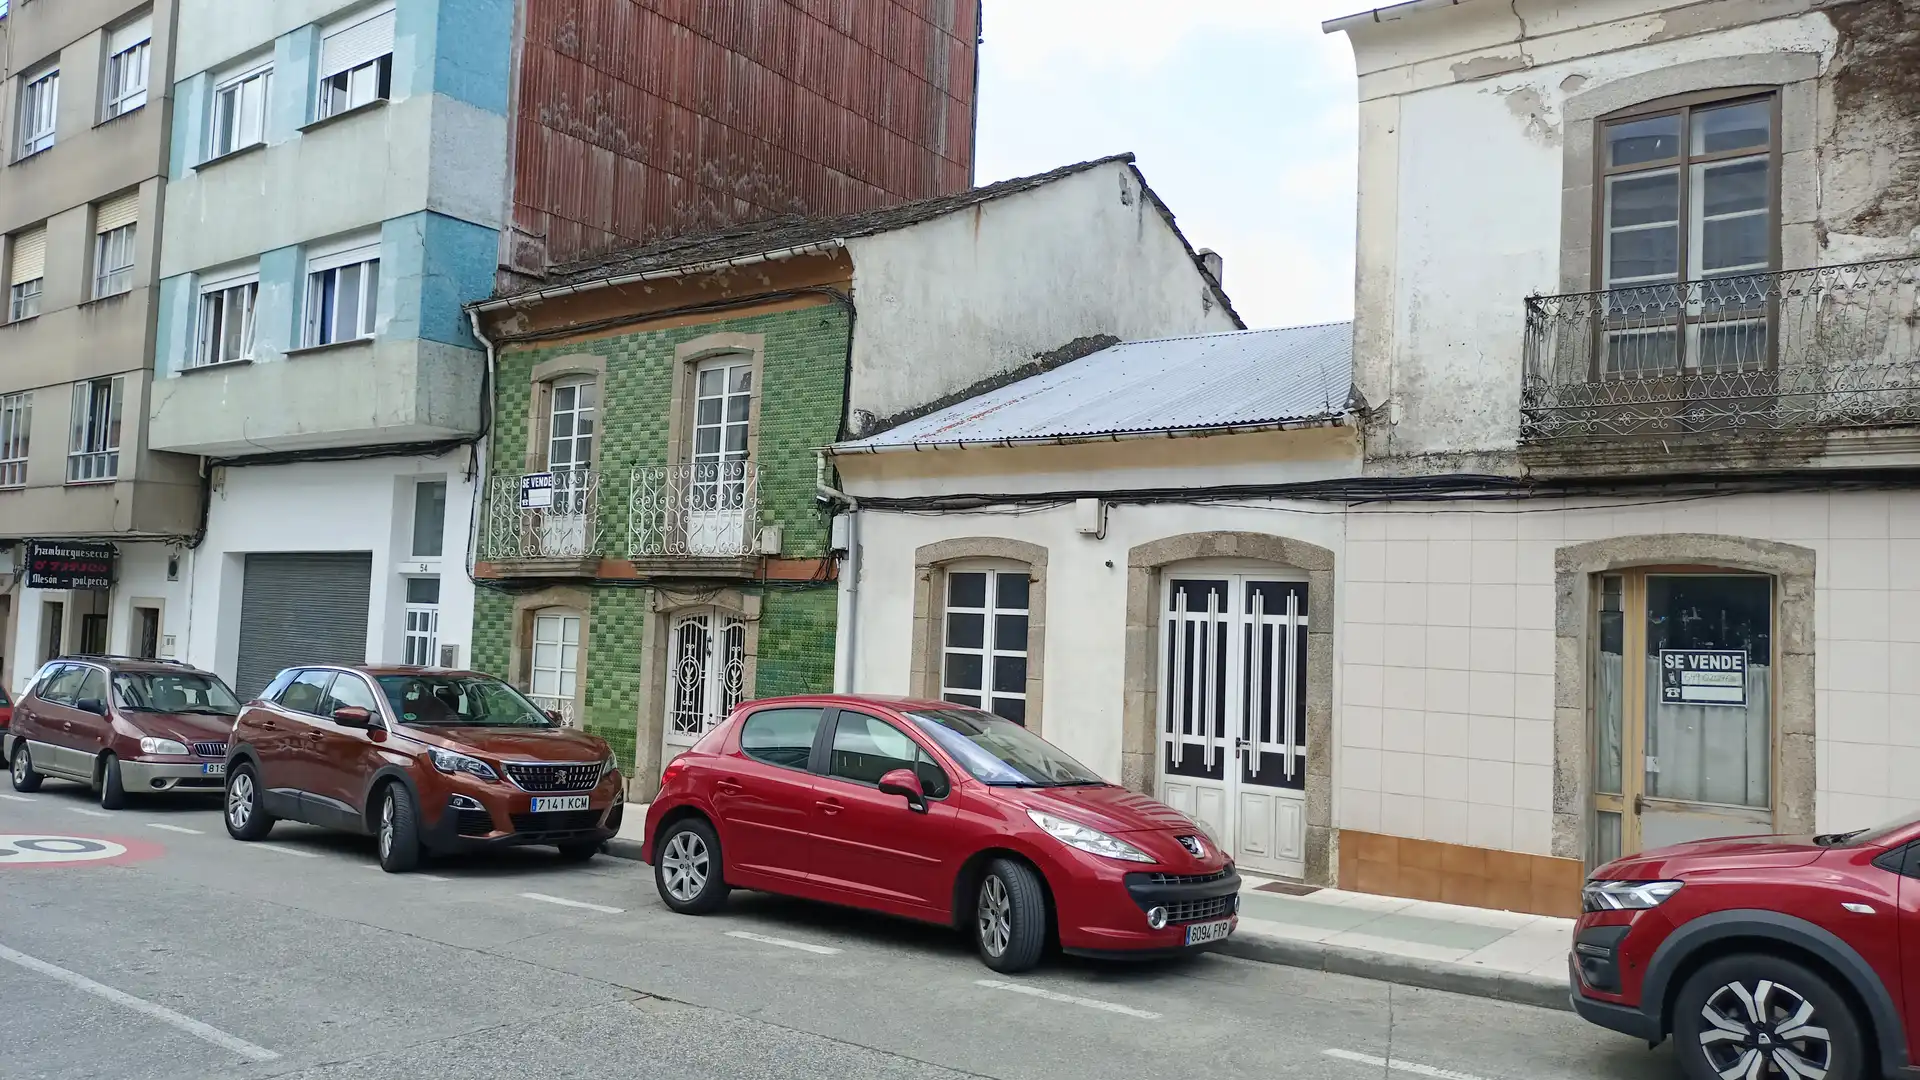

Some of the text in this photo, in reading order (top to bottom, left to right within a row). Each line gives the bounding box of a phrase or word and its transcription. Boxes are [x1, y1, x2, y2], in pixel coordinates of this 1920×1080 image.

[522, 476, 552, 488] SE VENDE
[420, 563, 428, 573] 54
[1664, 654, 1742, 670] SE VENDE
[539, 797, 587, 811] 7141 KCM
[1191, 924, 1211, 942] 6094
